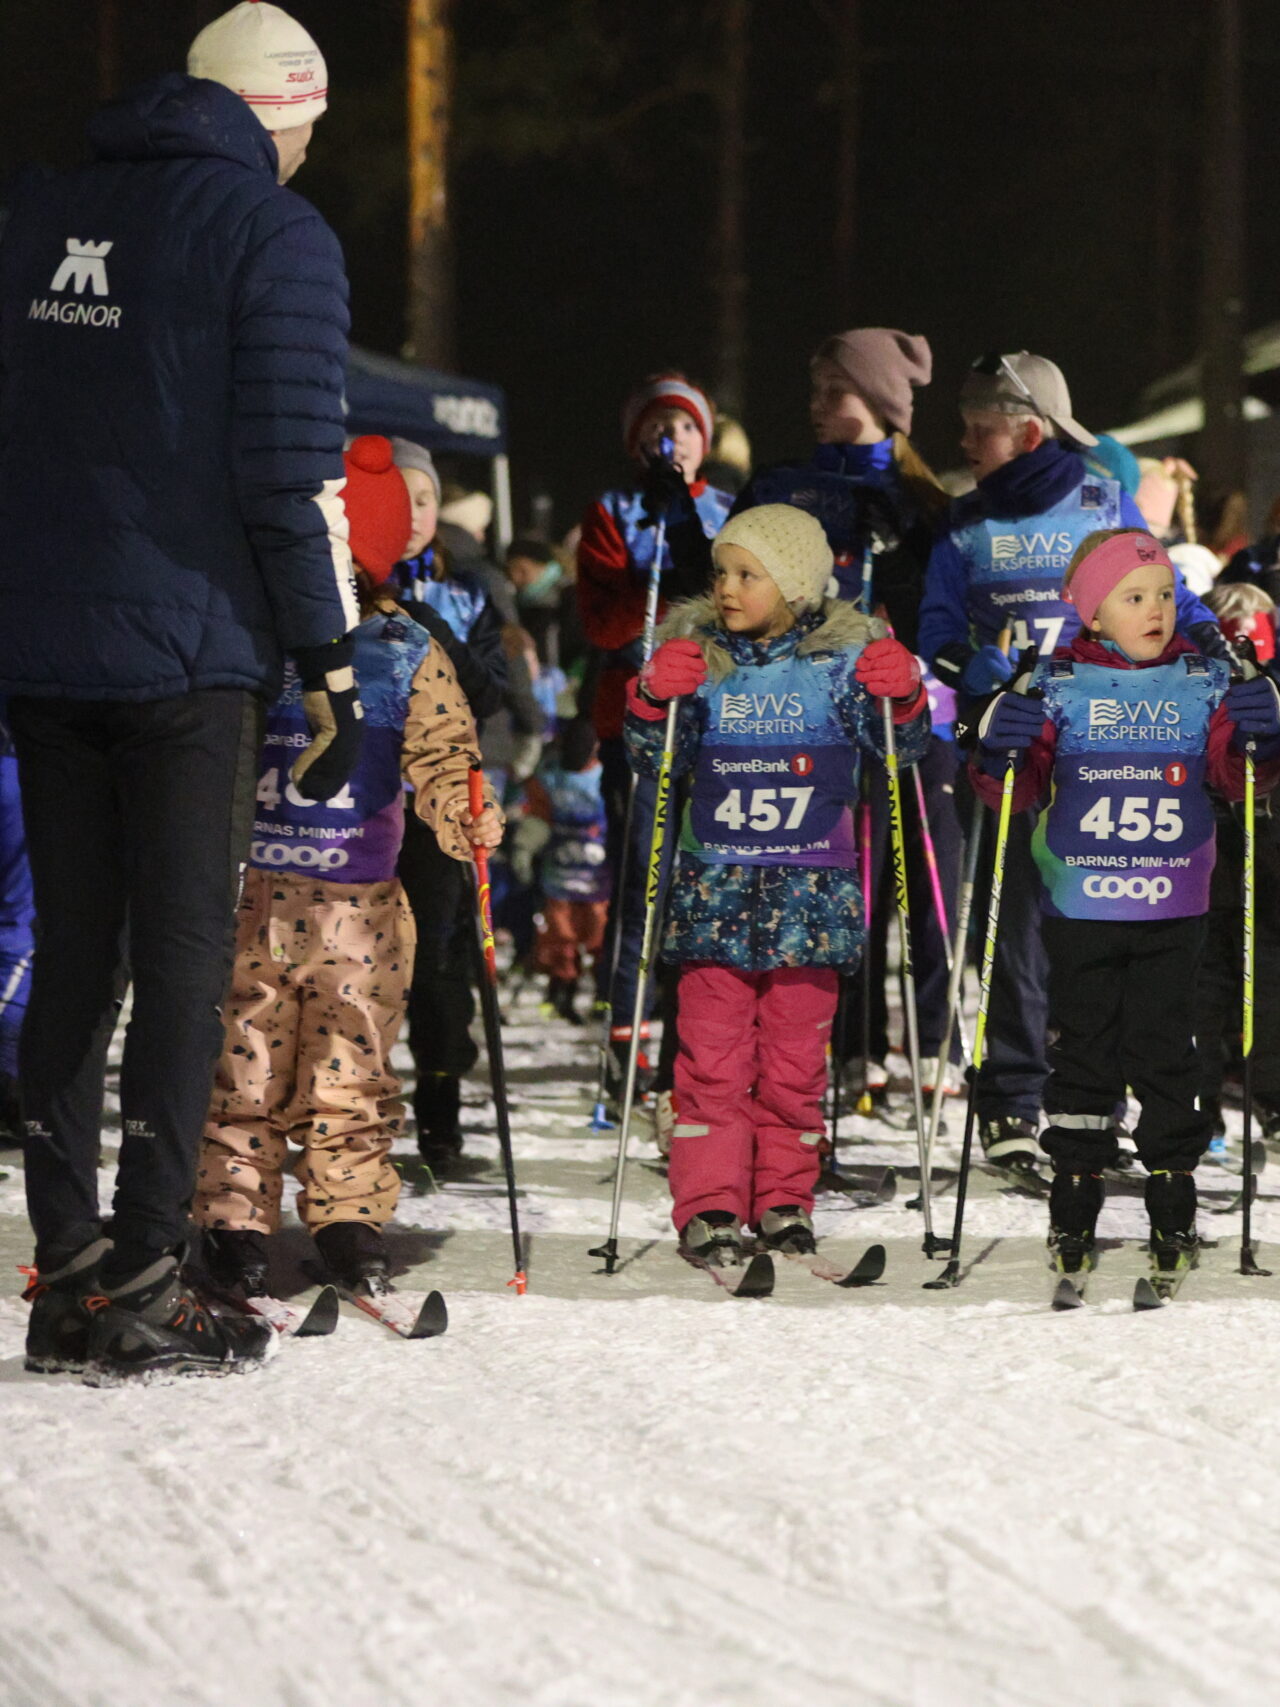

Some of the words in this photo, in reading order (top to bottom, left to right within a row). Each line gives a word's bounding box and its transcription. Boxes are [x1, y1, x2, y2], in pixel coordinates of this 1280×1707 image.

[27, 299, 122, 328] MAGNOR
[1021, 532, 1073, 555] VVS
[991, 588, 1060, 607] SpareBank
[752, 693, 804, 718] VVS
[1123, 700, 1181, 724] VVS
[719, 719, 804, 735] EKSPERTEN
[1087, 725, 1181, 741] EKSPERTEN
[712, 759, 790, 776] SpareBank
[796, 757, 807, 772] 1
[1078, 766, 1163, 783] SpareBank
[1171, 766, 1181, 782] 1
[714, 786, 815, 831] 457
[1079, 796, 1184, 842] 455
[249, 840, 349, 872] coop
[1065, 855, 1128, 868] BARNAS
[1132, 856, 1191, 869] MINI-VM
[1082, 875, 1173, 905] coop
